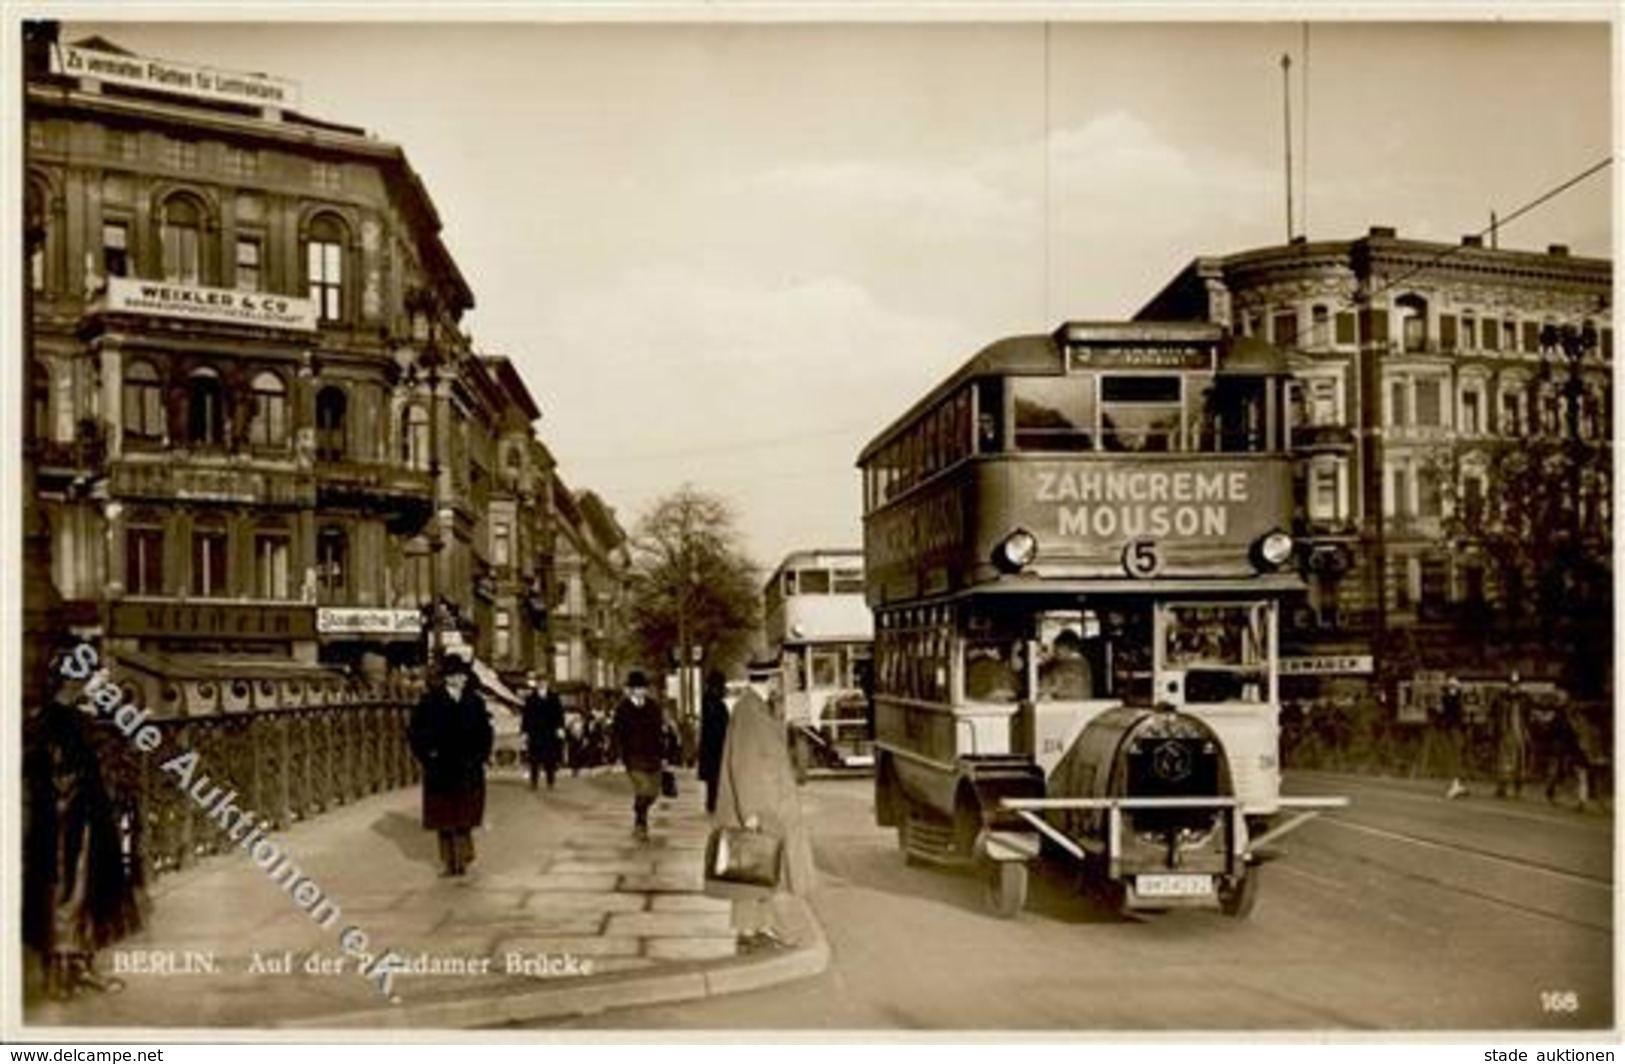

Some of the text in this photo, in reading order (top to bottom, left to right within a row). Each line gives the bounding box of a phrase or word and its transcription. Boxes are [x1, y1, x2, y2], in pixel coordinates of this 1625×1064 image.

[242, 297, 257, 310] &
[1037, 472, 1248, 500] ZAHNCREME
[1058, 505, 1228, 536] MOUSON
[1134, 541, 1156, 572] 5
